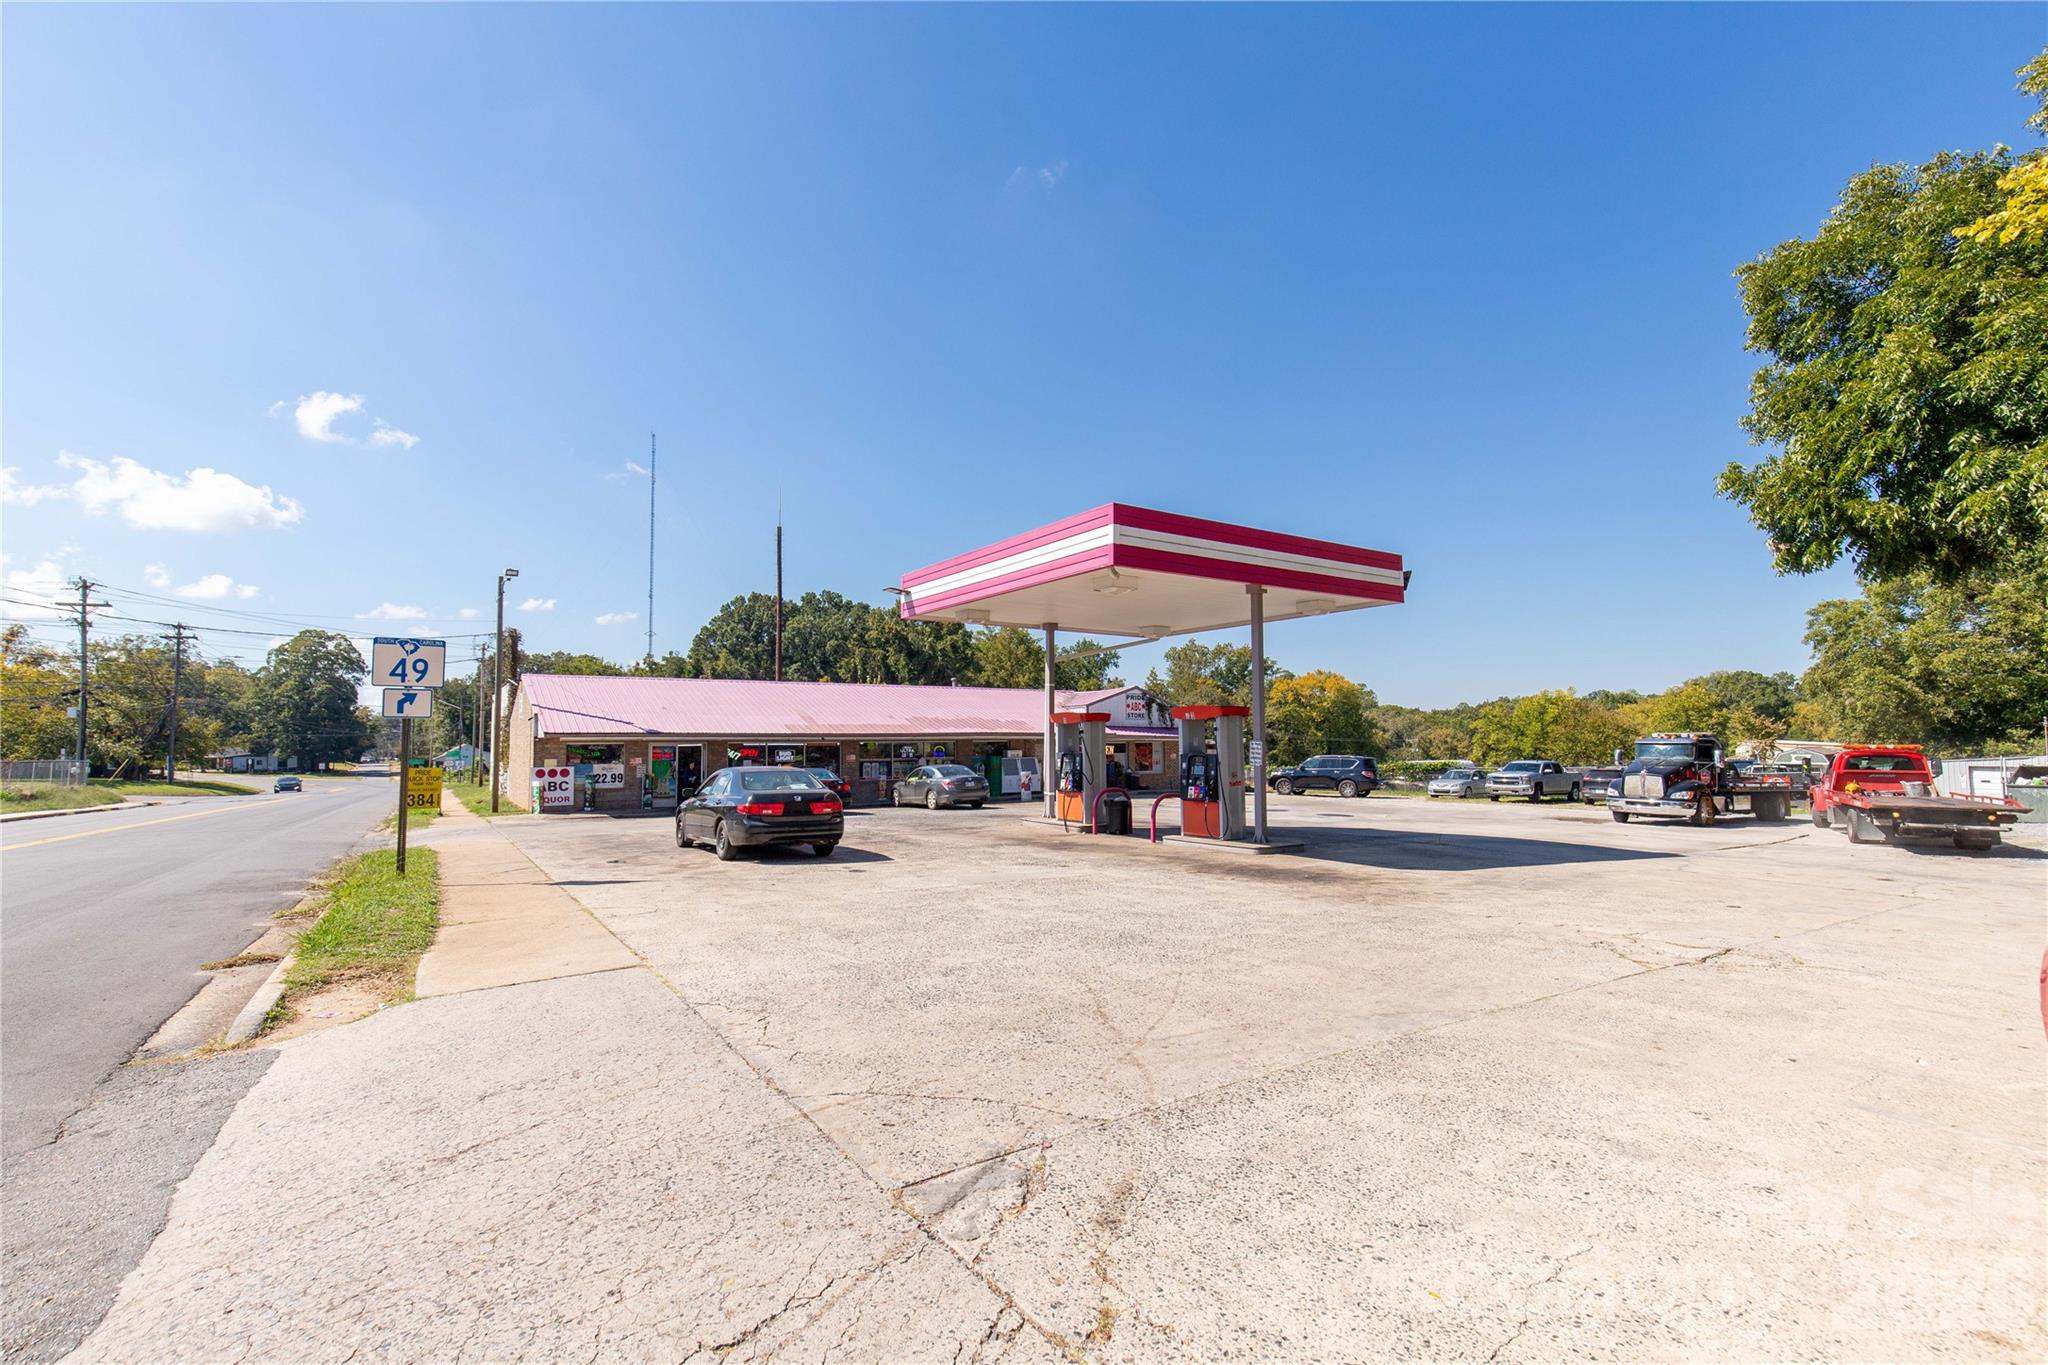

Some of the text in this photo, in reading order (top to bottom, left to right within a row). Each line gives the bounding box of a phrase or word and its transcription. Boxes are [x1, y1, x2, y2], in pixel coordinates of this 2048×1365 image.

[388, 658, 429, 683] 49
[1131, 702, 1142, 711] ABC
[740, 748, 758, 757] OPEN
[595, 773, 624, 784] 22.99
[407, 794, 435, 807] 384
[543, 796, 570, 804] QUOR
